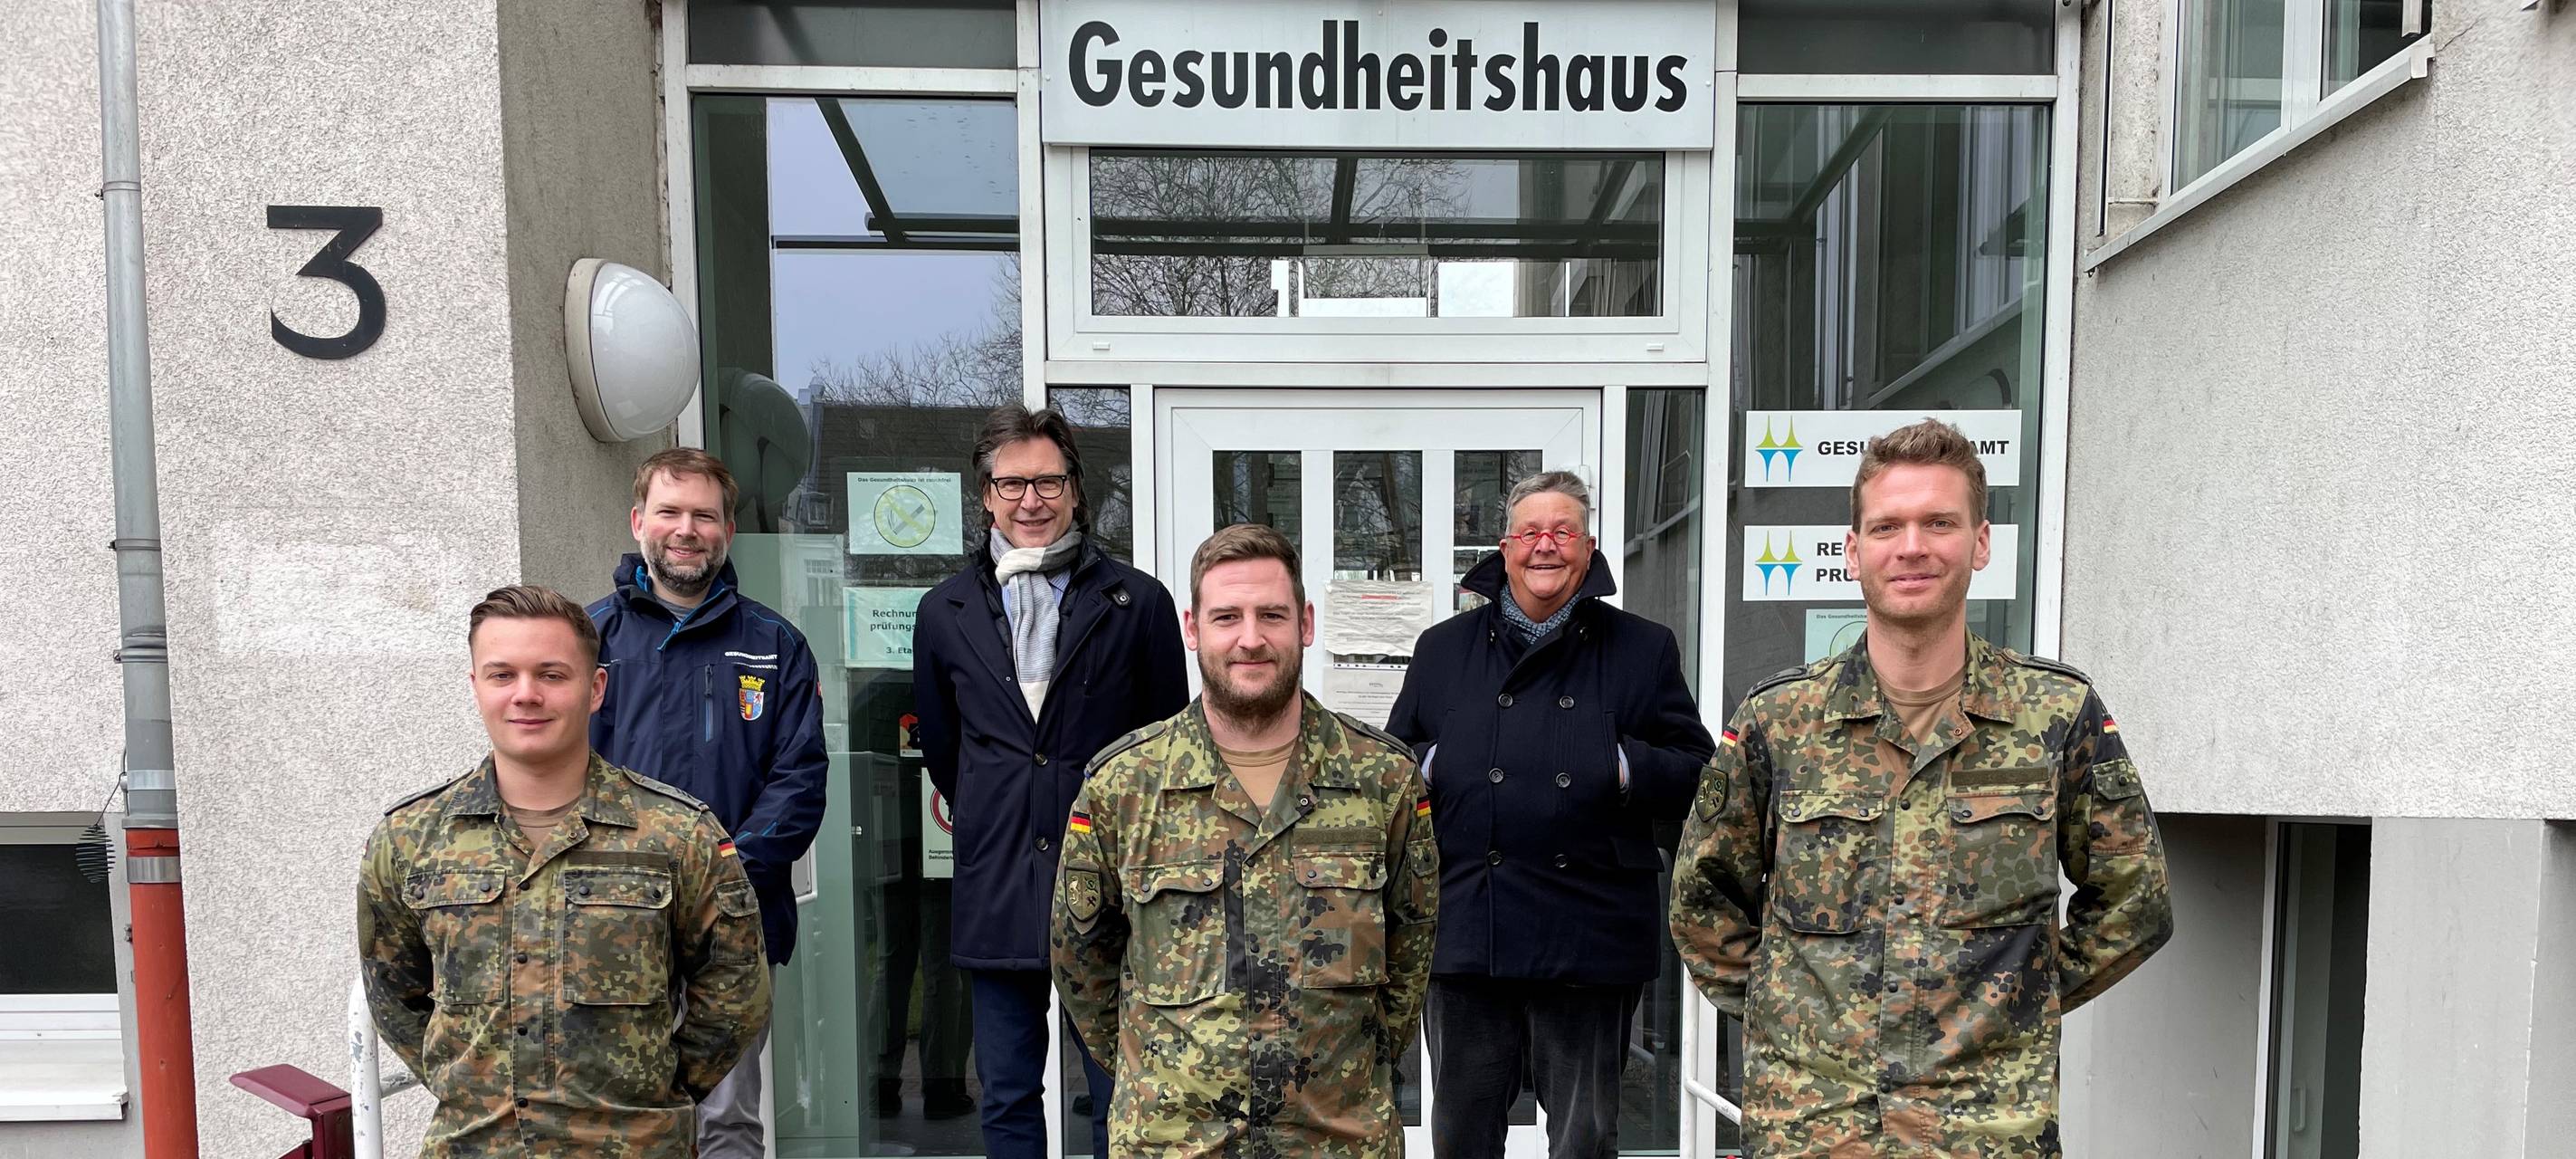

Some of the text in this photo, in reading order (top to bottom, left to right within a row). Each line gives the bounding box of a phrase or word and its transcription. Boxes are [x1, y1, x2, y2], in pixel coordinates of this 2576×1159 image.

[1068, 19, 1687, 112] Gesundheitshaus
[267, 206, 386, 359] 3
[1817, 542, 1846, 556] RE
